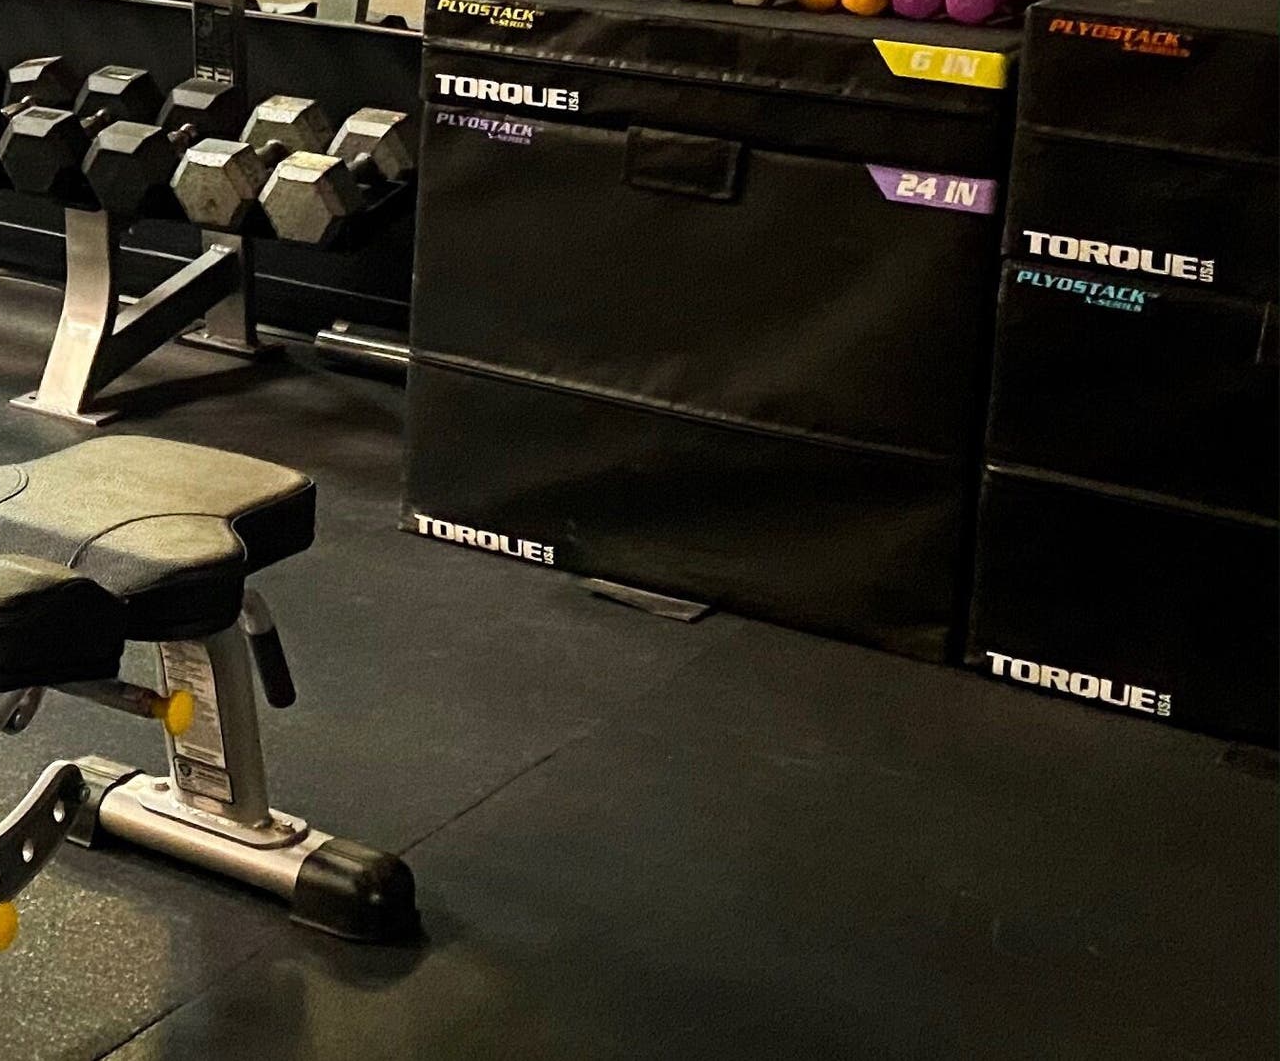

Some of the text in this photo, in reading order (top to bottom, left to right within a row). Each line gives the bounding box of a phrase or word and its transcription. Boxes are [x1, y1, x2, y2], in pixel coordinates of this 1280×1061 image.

[1048, 18, 1180, 47] PLYOSTACK
[909, 51, 981, 77] 6 IN
[435, 74, 579, 111] TORQUE USA
[436, 112, 533, 137] PLYOSTACK
[896, 174, 979, 207] 24 IN
[1023, 230, 1214, 283] TORQUE USA
[1016, 270, 1146, 304] PLYOSTACK
[414, 513, 555, 566] TORQUE USA
[986, 651, 1172, 717] TORQUE USA
